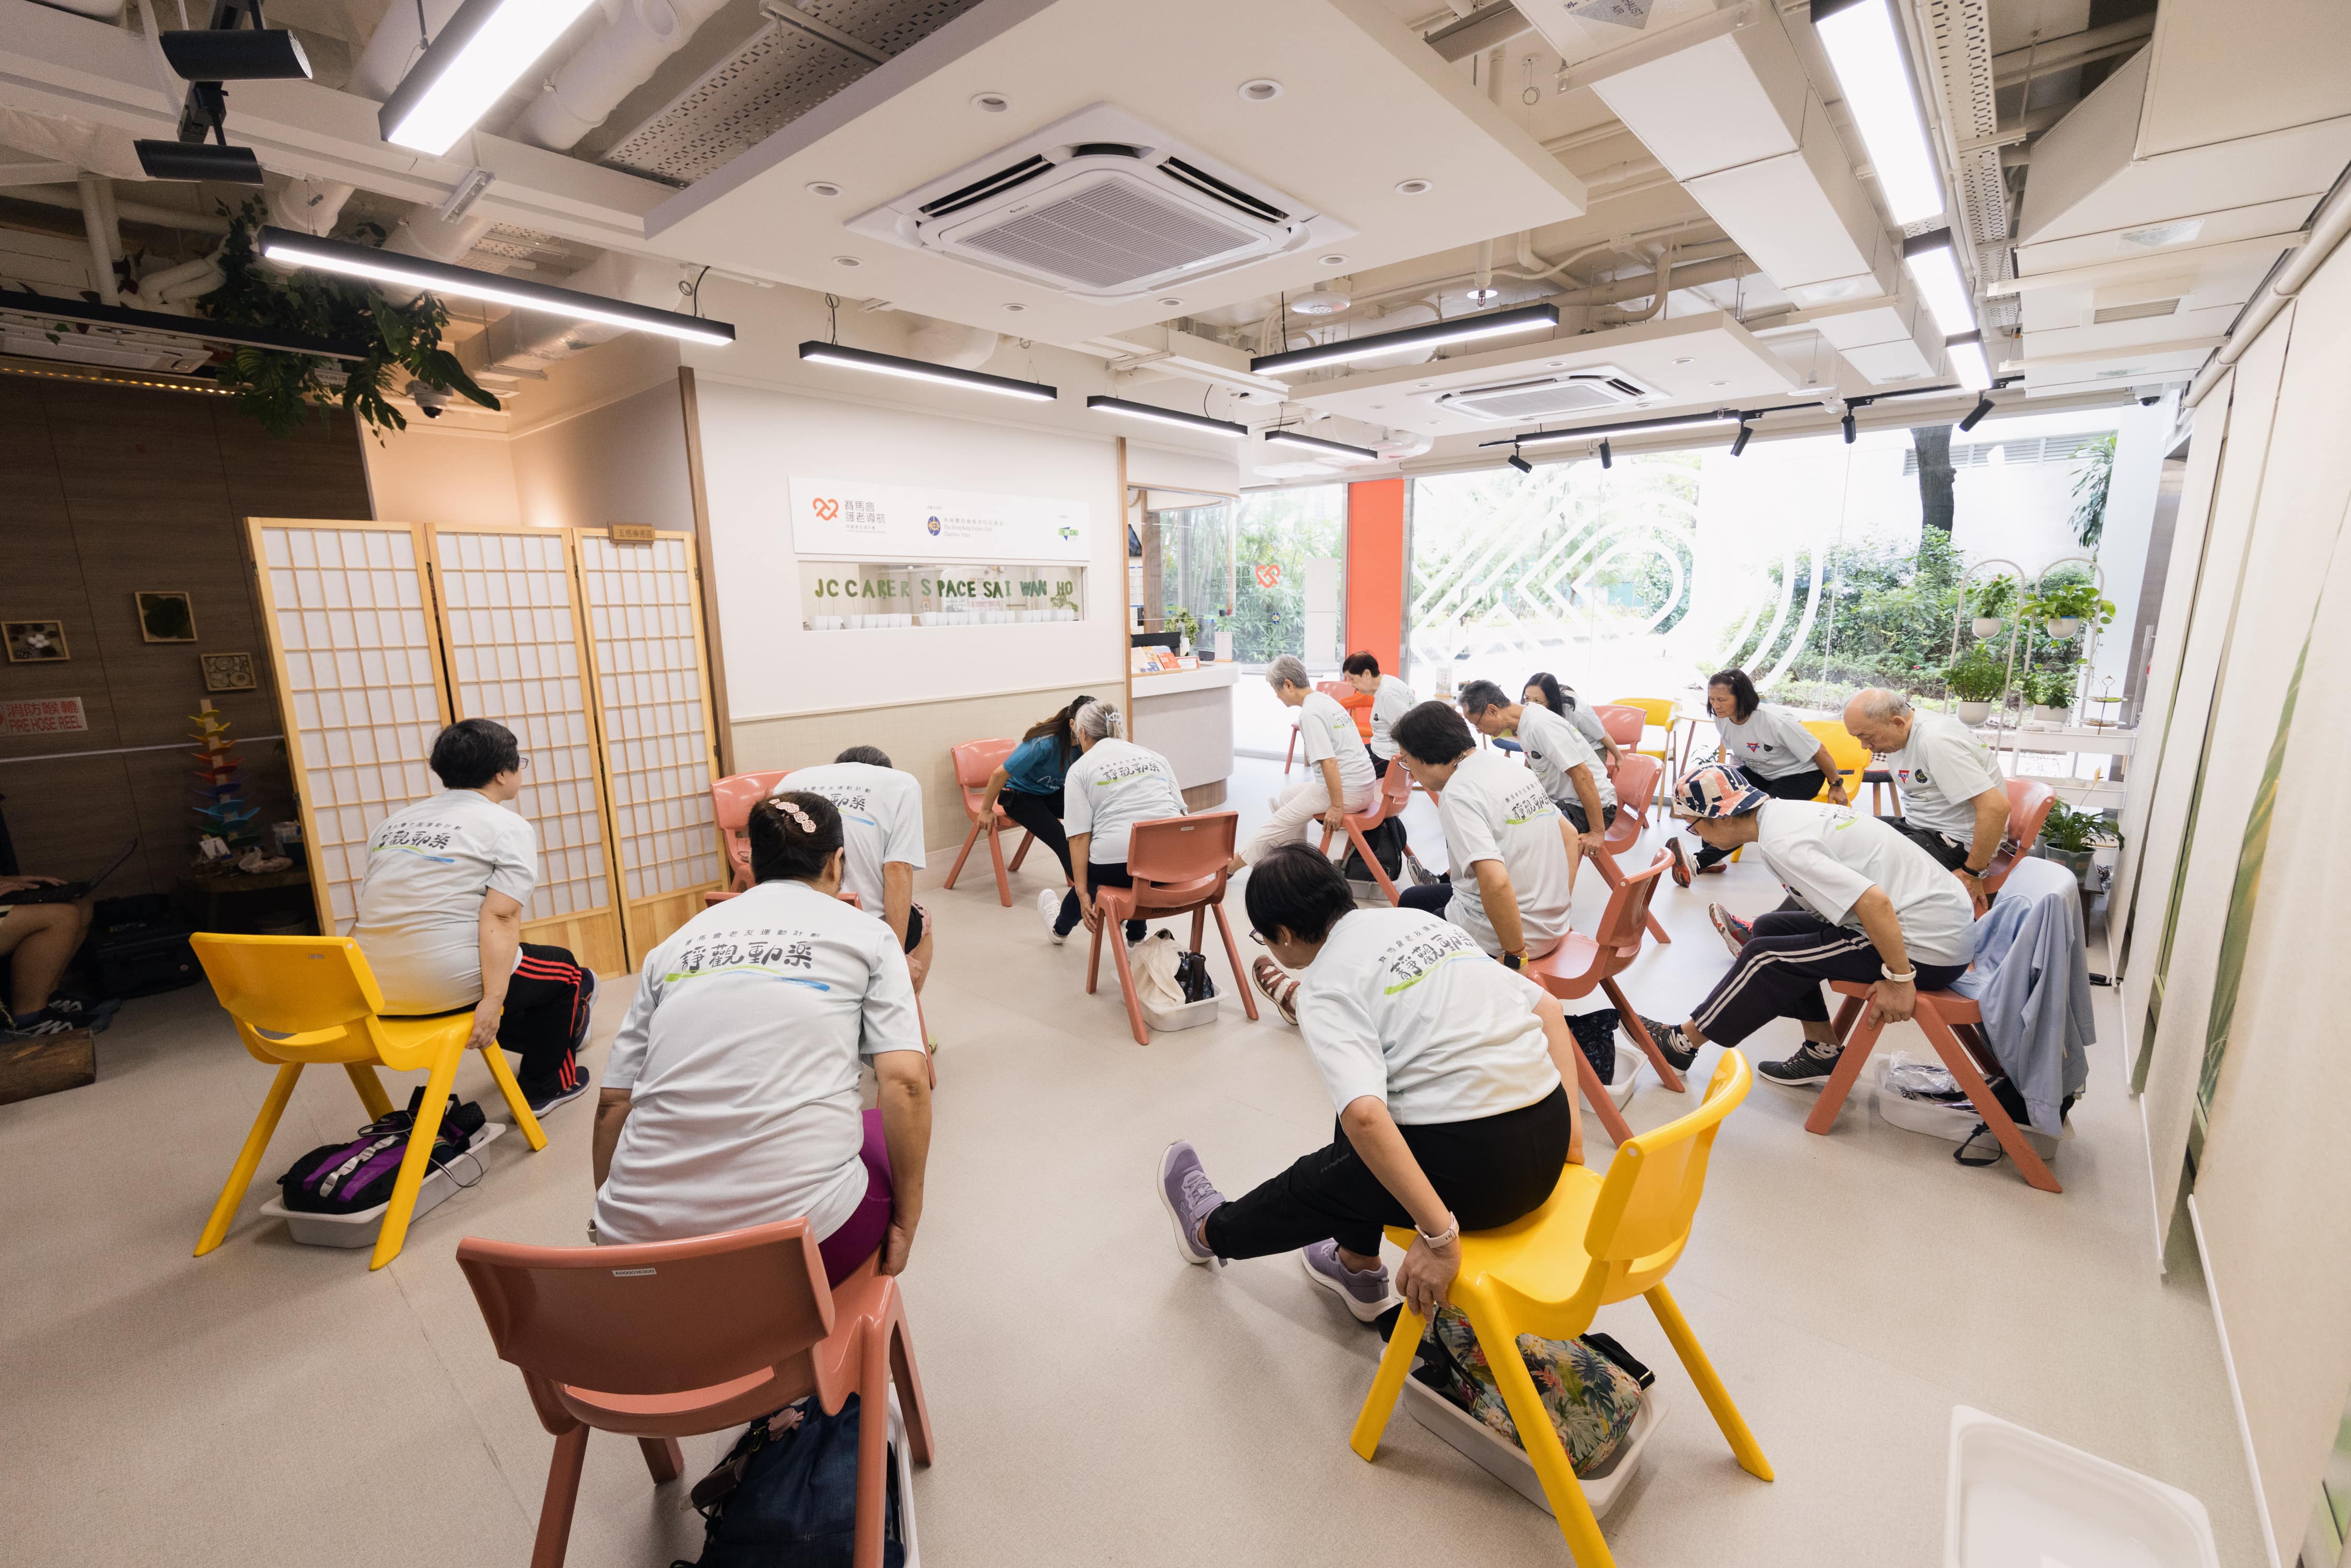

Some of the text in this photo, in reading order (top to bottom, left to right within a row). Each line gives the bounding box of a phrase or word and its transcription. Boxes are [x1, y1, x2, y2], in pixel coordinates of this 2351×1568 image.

[1610, 5, 1624, 17] AIR
[1622, 0, 1644, 17] HAUST
[844, 500, 875, 513] 賽馬會
[815, 578, 1073, 598] JC CARER SPACE SAI WAN HO
[9, 715, 83, 733] FIRE HOSE REEL
